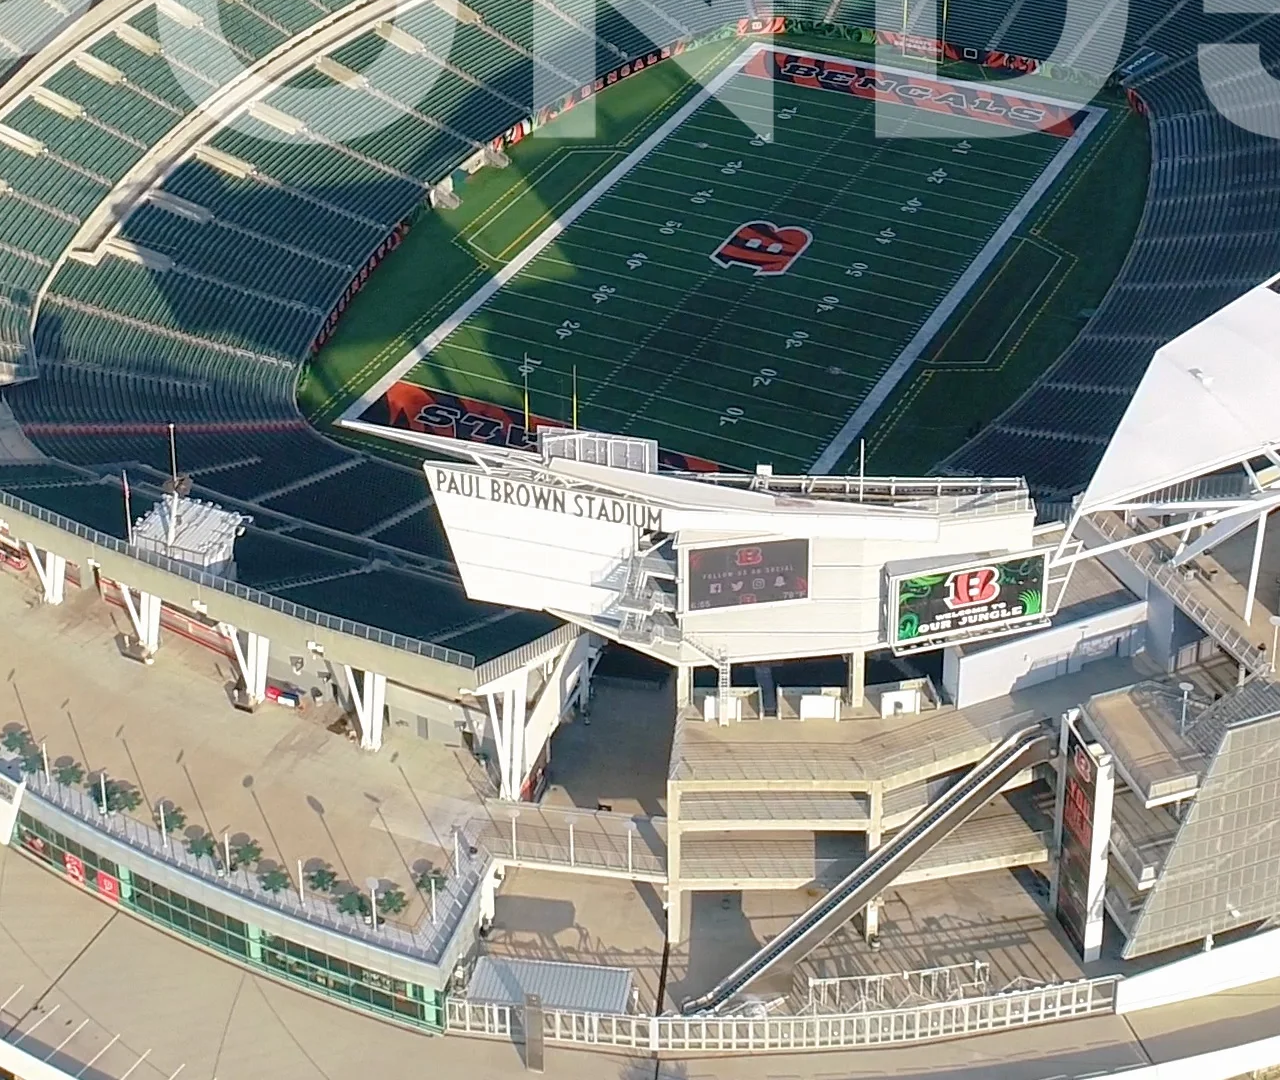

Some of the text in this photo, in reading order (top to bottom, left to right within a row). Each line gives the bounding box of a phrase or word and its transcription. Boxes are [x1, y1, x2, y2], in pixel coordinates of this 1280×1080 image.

[581, 46, 671, 98] BENGALS
[780, 62, 1046, 122] BENGALS
[436, 469, 663, 532] PAUL BROWN STADIUM
[918, 605, 1023, 634] OUR JUNGLE
[935, 602, 1007, 621] WELCOME TO
